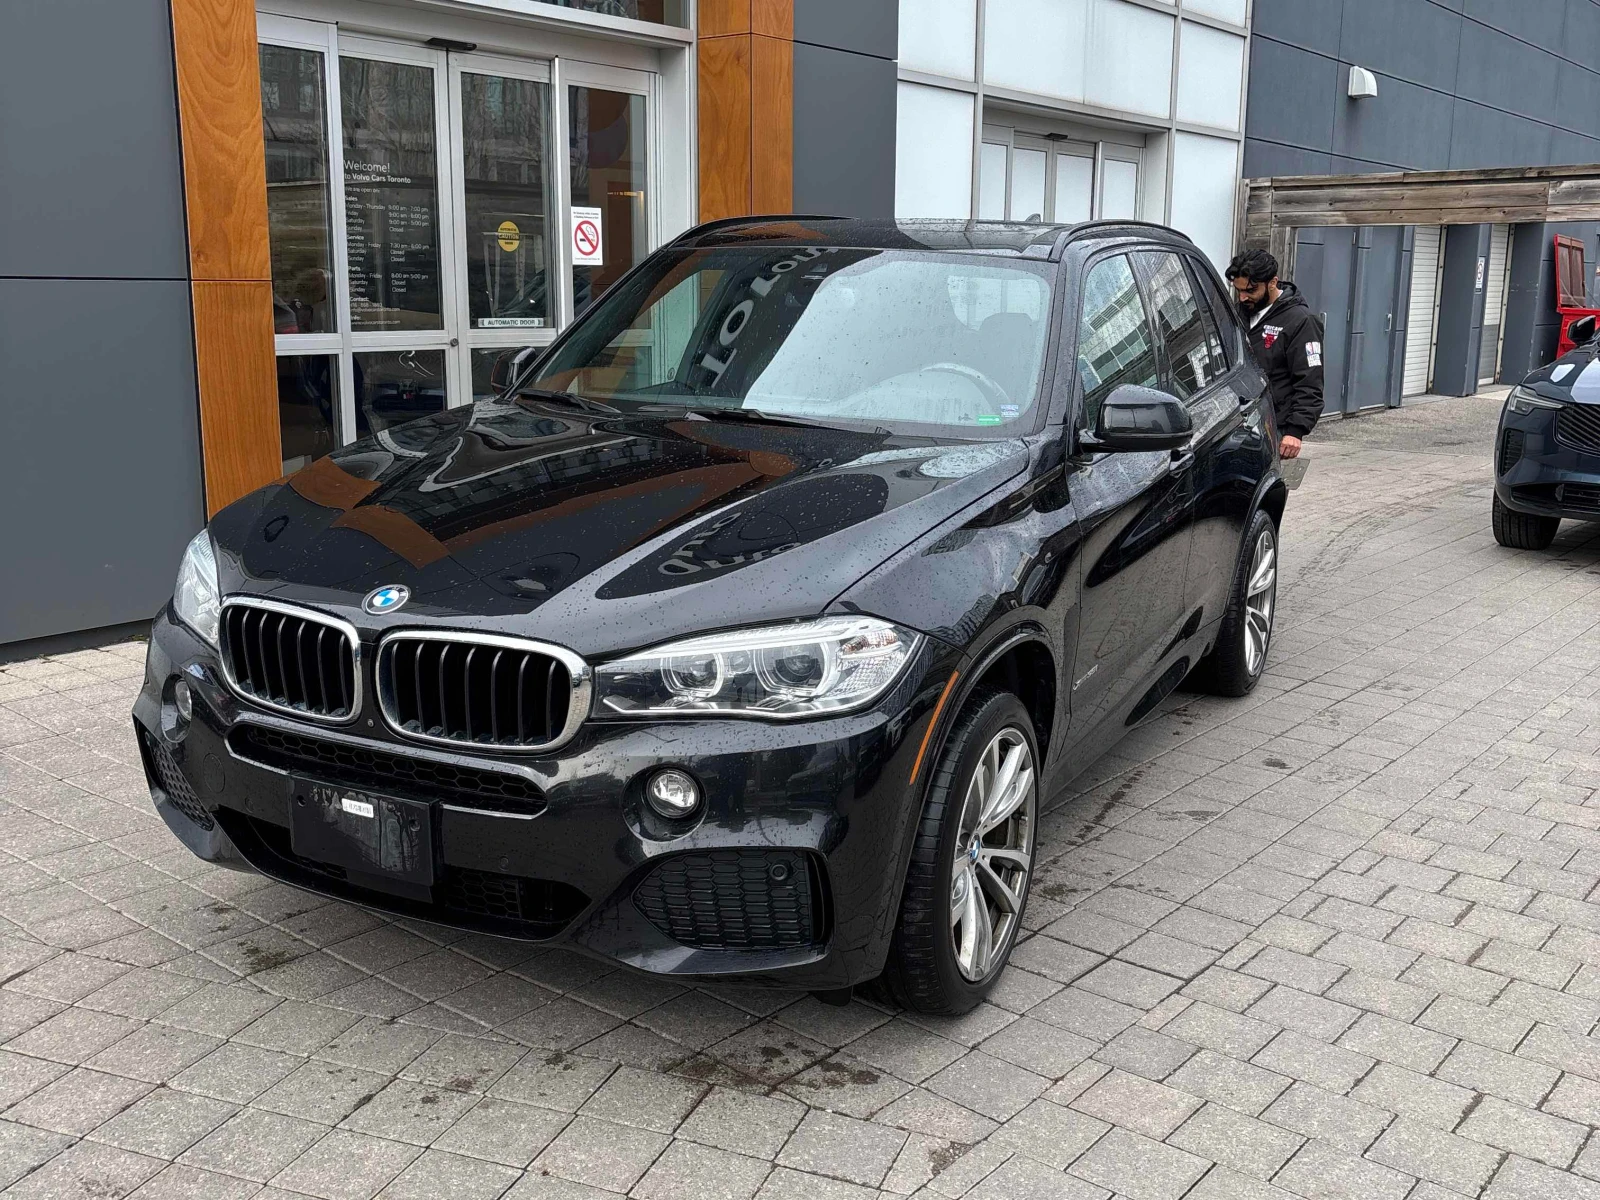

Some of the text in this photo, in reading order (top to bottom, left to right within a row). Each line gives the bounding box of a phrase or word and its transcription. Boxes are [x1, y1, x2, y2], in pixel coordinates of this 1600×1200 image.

[344, 160, 390, 172] Welcome!
[352, 173, 370, 181] Volvo
[371, 174, 386, 182] Cars
[387, 175, 411, 184] Toronto
